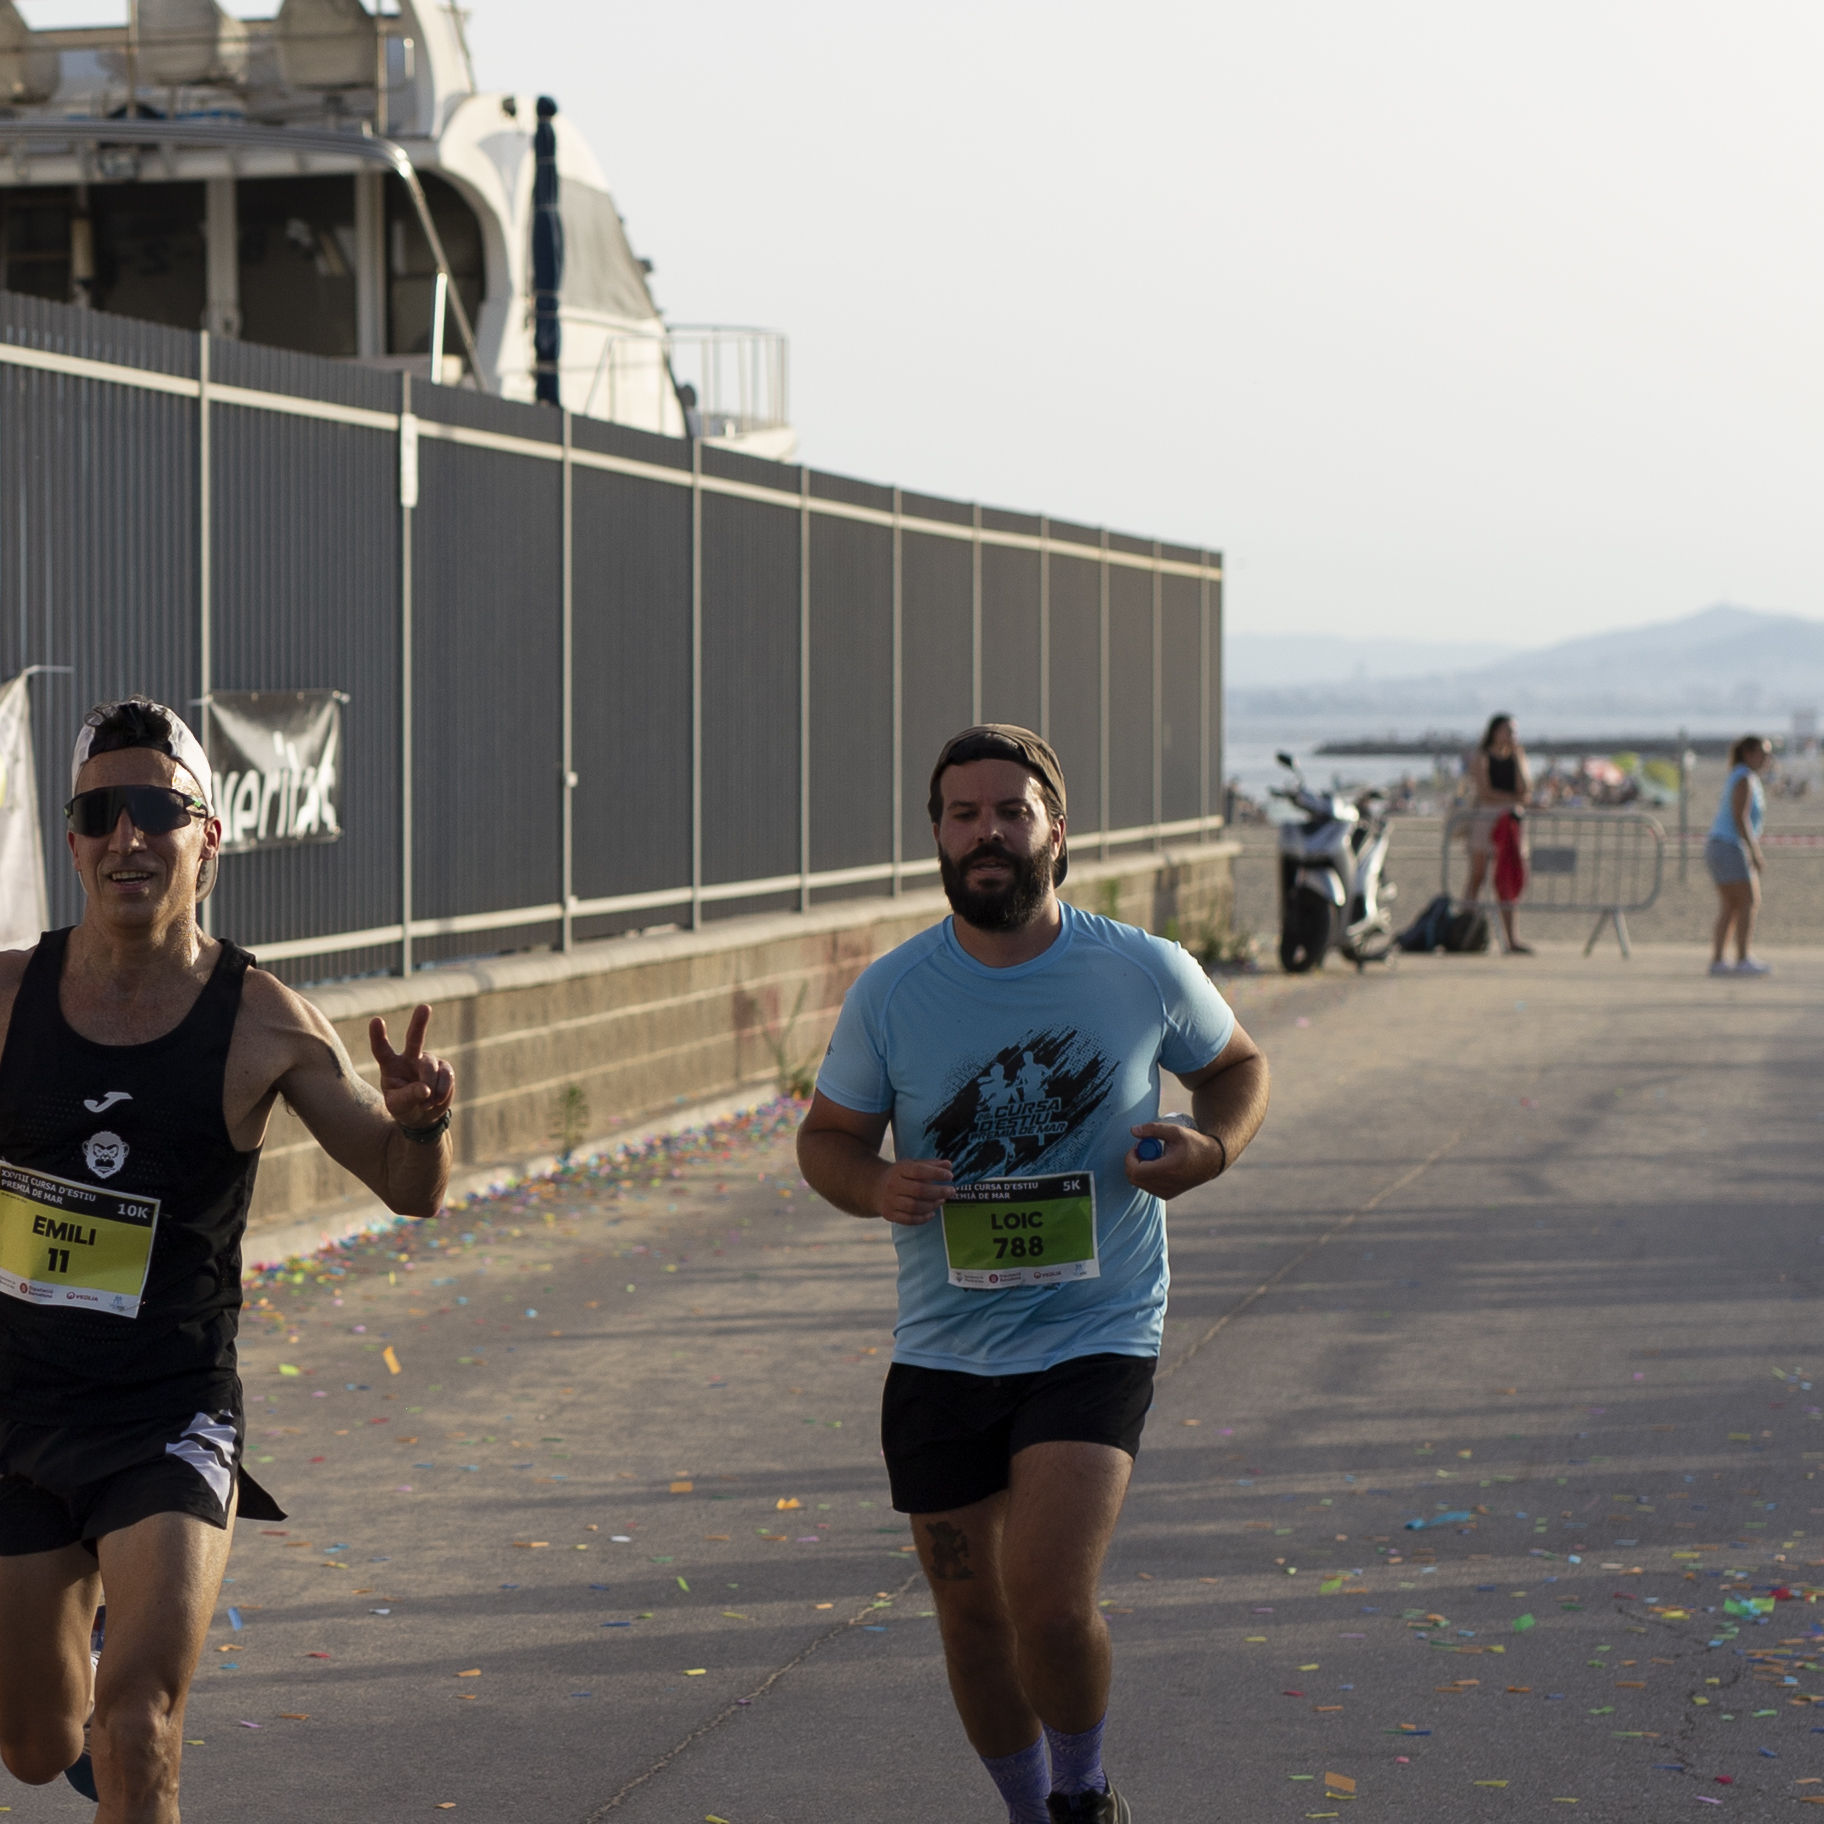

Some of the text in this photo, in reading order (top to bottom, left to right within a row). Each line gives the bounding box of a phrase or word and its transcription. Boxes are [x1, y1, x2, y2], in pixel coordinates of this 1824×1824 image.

[994, 1098, 1060, 1118] CURSA
[1037, 1122, 1066, 1134] MAR
[30, 1177, 56, 1192] CURSA
[58, 1186, 97, 1202] D'ESTIU
[974, 1183, 1002, 1191] CURSA
[1062, 1179, 1081, 1192] 5K
[31, 1188, 43, 1198] DE
[43, 1192, 64, 1205] MAR
[978, 1192, 989, 1200] DE
[991, 1191, 1011, 1200] MAR
[117, 1203, 149, 1219] 10K
[990, 1211, 1044, 1230] LOIC
[32, 1214, 97, 1246] EMILI
[992, 1235, 1044, 1259] 788
[47, 1247, 70, 1273] 11
